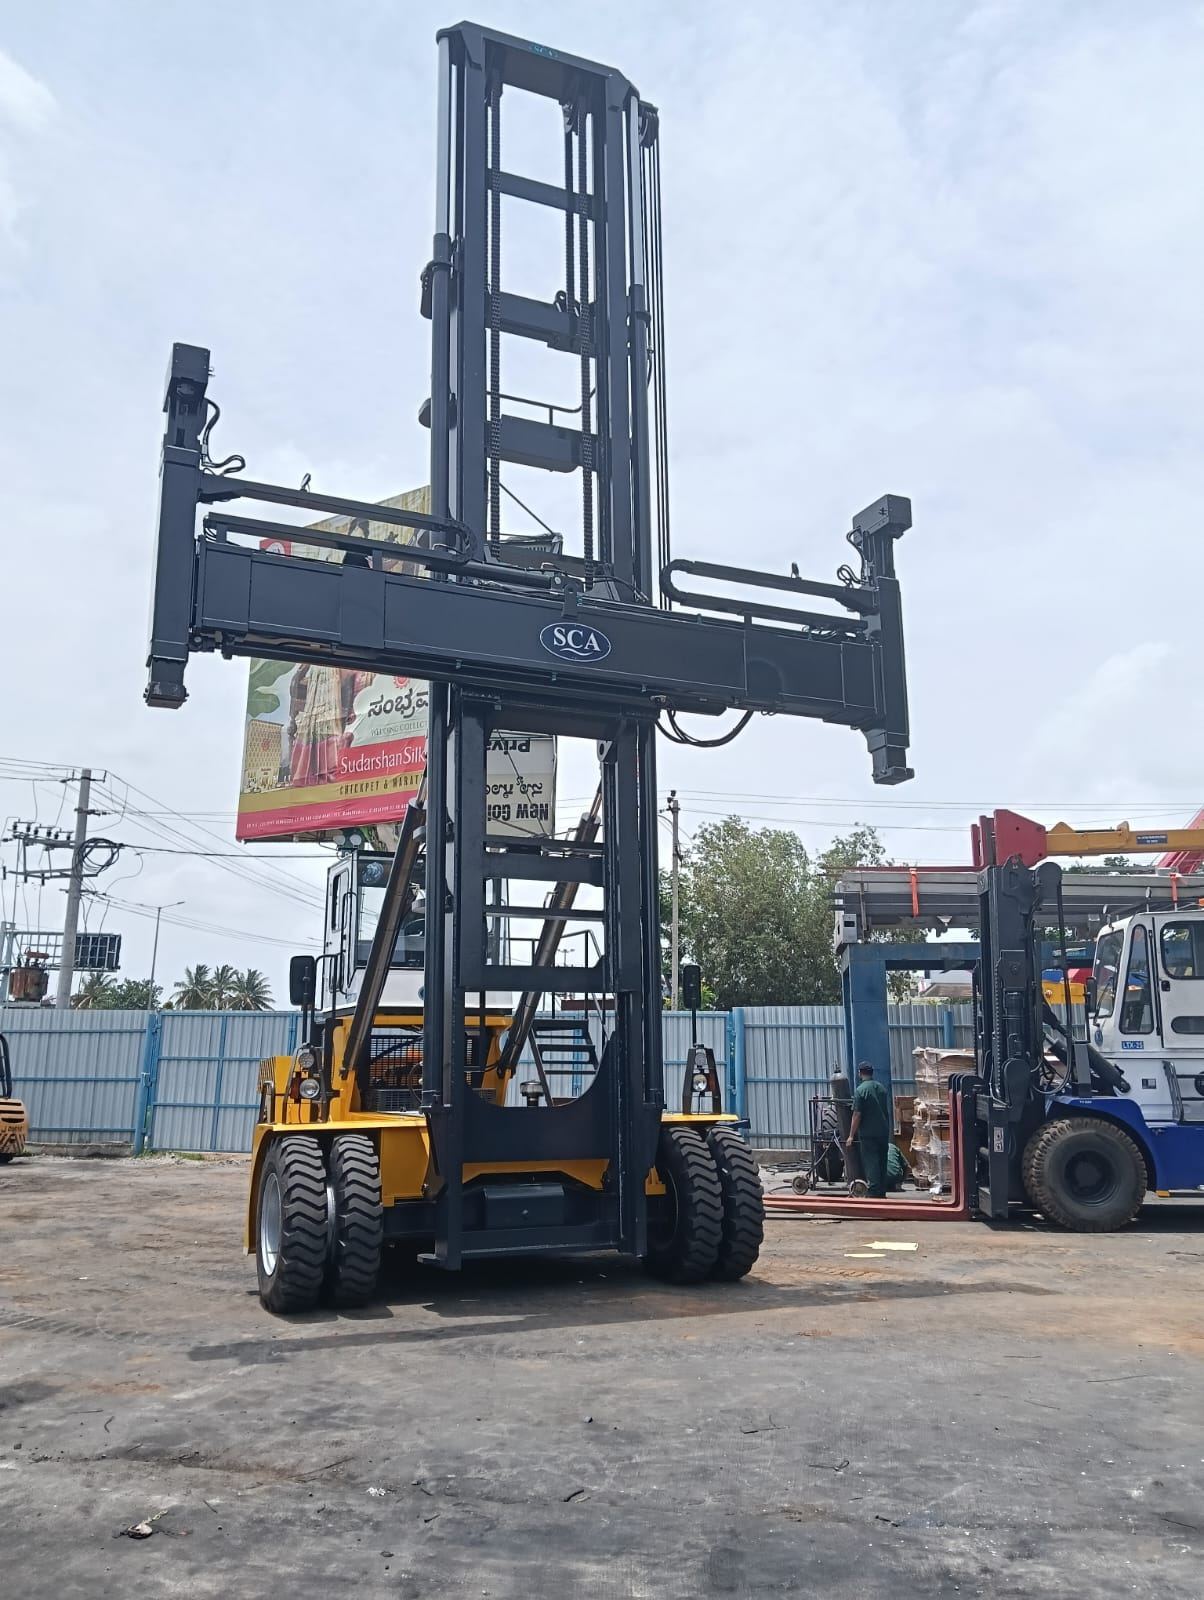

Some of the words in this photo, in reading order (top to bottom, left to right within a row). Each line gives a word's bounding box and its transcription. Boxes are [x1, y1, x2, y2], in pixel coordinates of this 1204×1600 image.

[554, 627, 601, 651] SCA
[393, 774, 422, 788] MARAT
[516, 803, 549, 821] New
